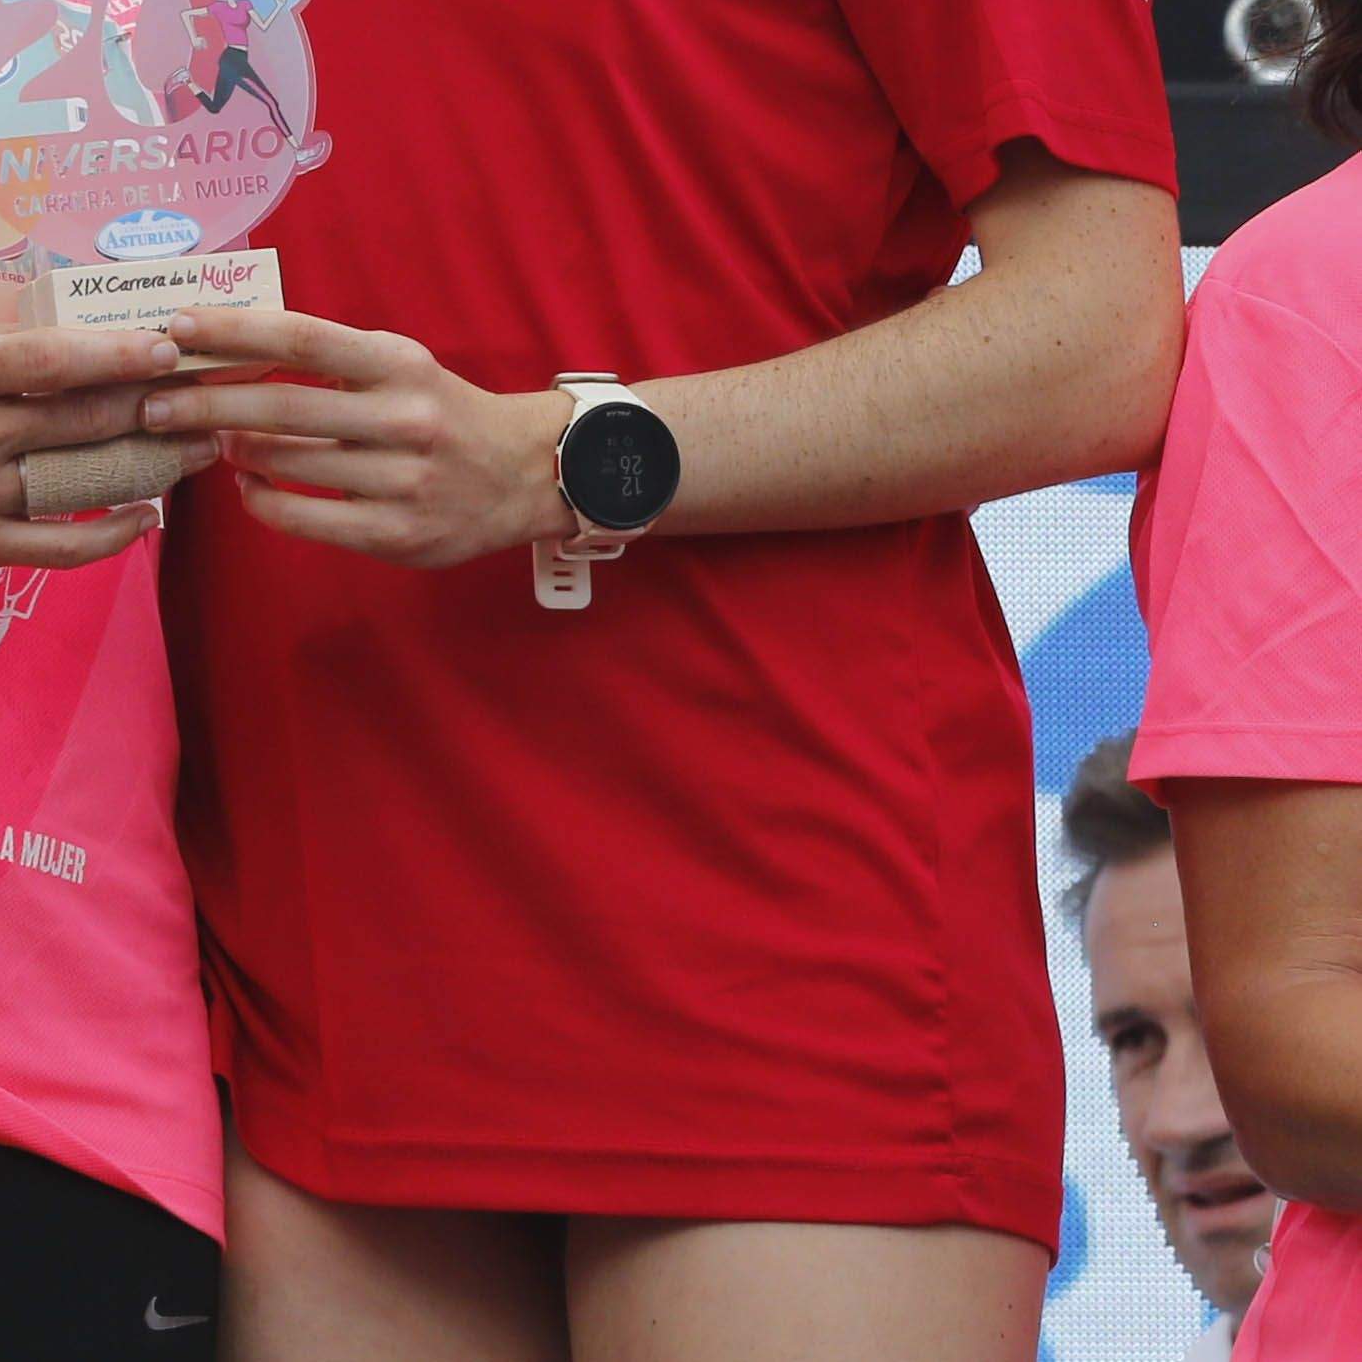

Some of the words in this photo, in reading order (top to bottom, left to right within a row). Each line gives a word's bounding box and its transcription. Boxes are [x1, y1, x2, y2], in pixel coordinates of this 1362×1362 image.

[13, 190, 117, 218] CARRERA
[124, 184, 150, 207] DE
[166, 181, 186, 203] LA
[195, 175, 270, 199] MUJER
[105, 229, 195, 249] ASTURIANA
[69, 275, 103, 298] XIX
[106, 275, 166, 294] Carrera
[170, 271, 185, 286] de
[186, 269, 198, 283] la
[198, 259, 259, 294] Mujer
[19, 830, 87, 884] MUJER
